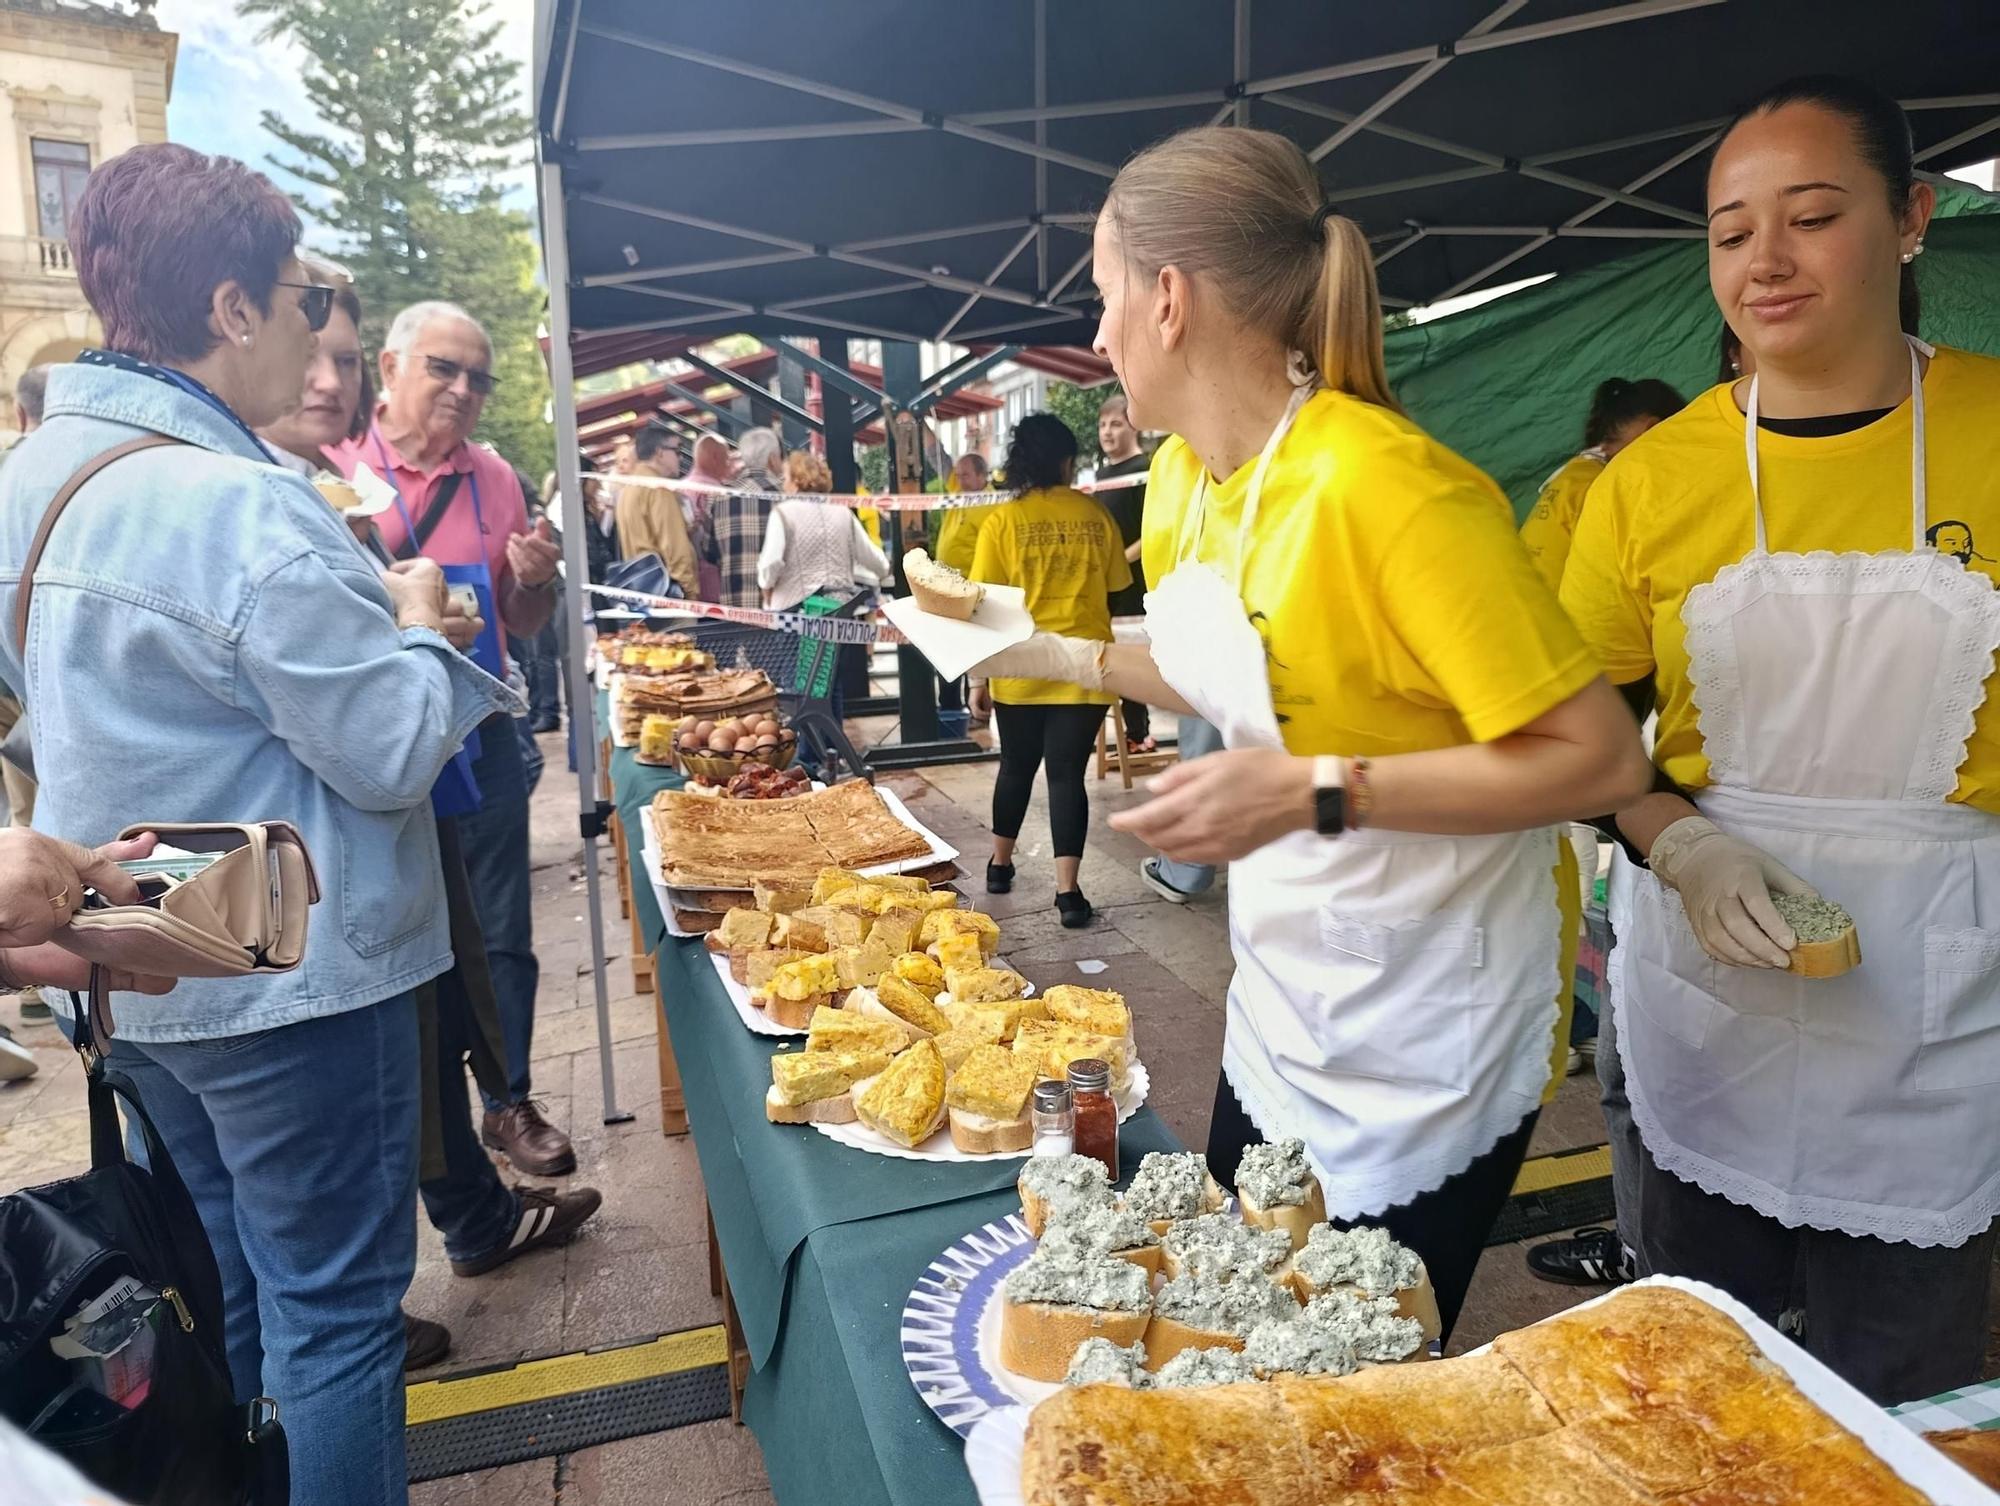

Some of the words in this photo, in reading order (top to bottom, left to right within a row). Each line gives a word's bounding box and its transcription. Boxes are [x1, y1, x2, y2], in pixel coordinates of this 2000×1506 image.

[727, 608, 775, 624] SEGURIDAD
[801, 618, 834, 639] LOCAL
[838, 621, 877, 642] POLICIA
